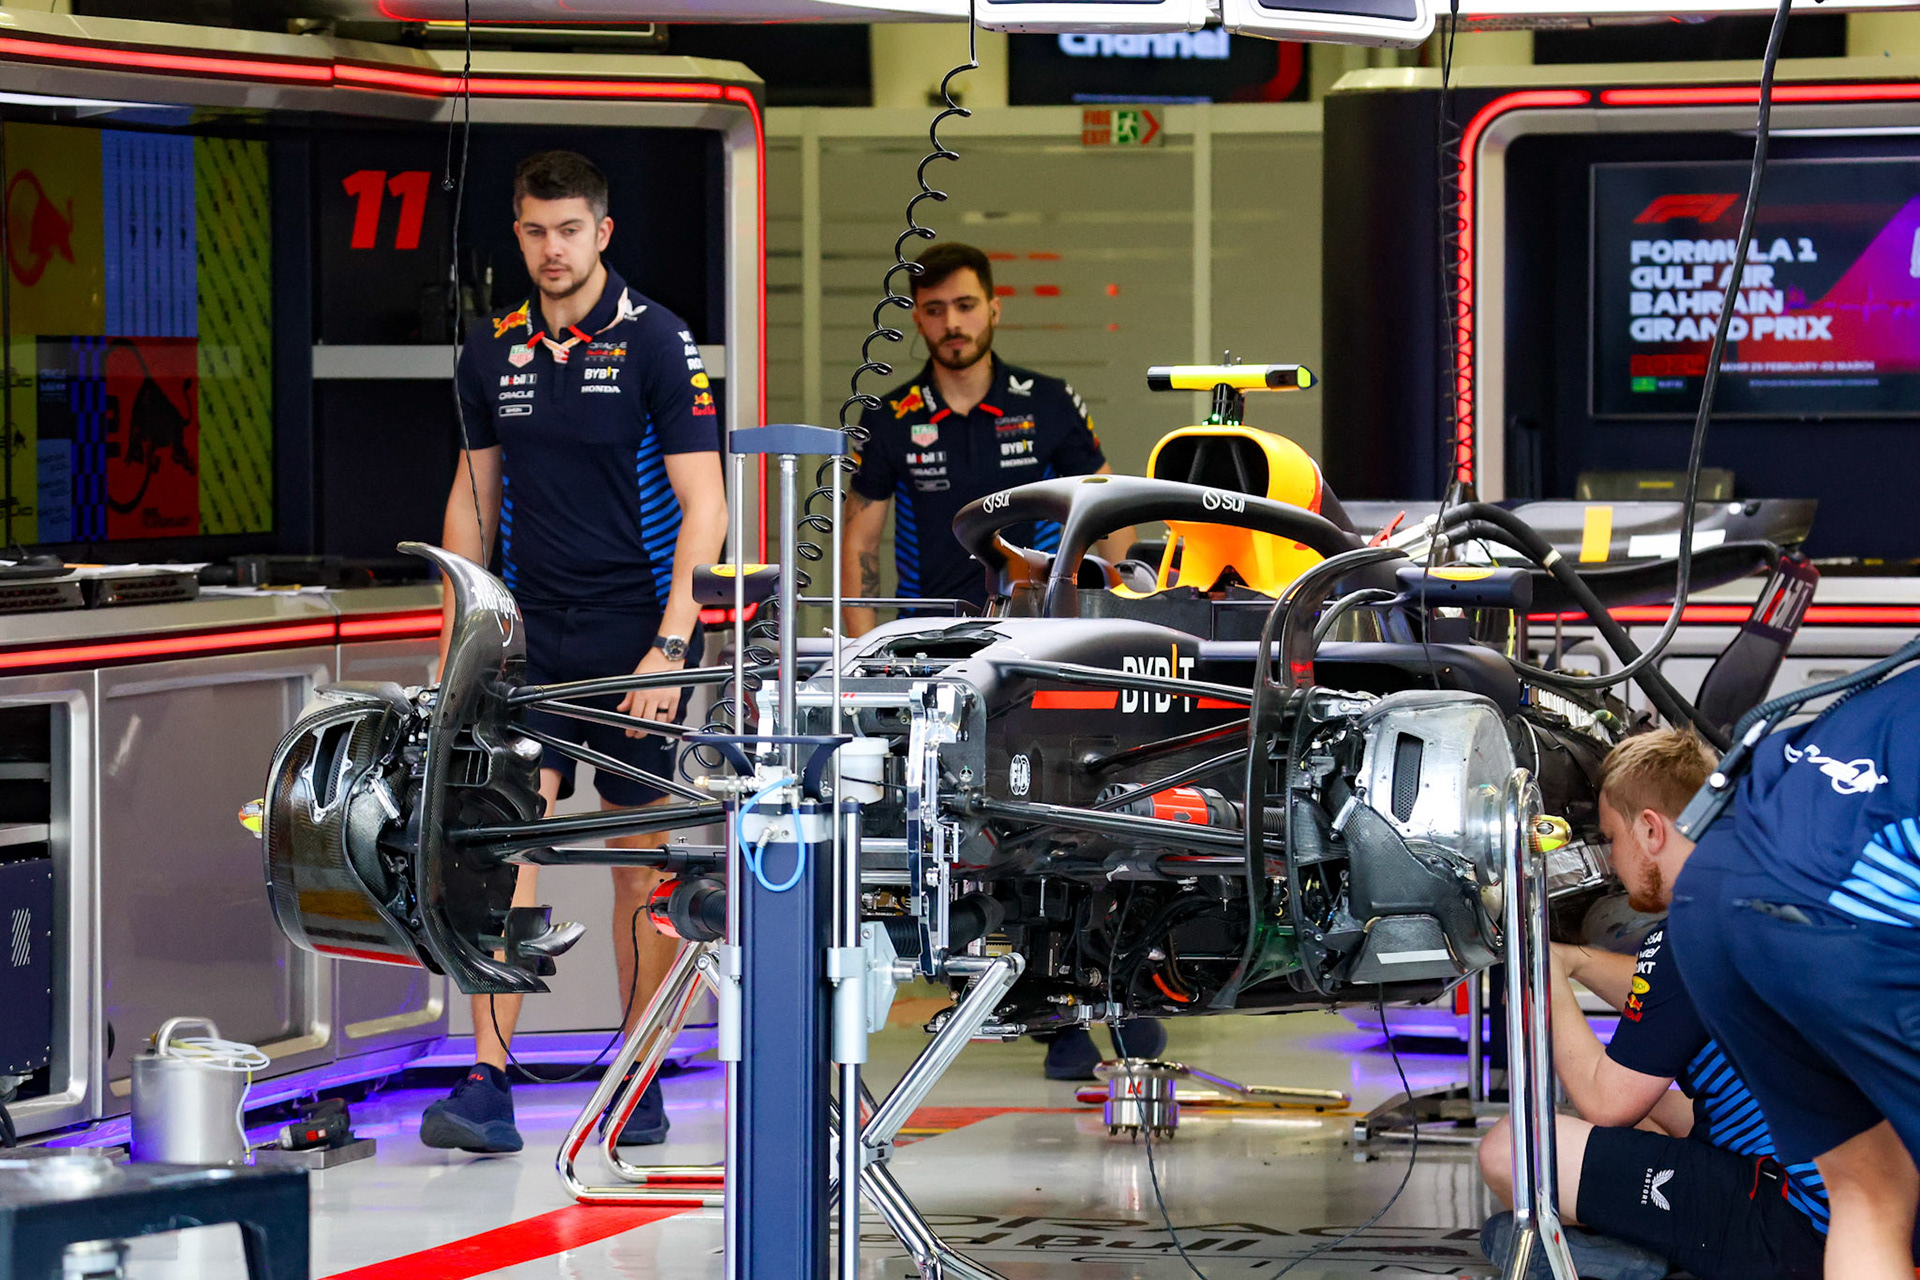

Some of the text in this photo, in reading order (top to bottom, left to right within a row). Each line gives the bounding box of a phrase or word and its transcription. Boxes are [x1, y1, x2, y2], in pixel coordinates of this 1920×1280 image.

[342, 169, 431, 250] 11
[1629, 264, 1775, 289] GULF AIR
[1629, 289, 1784, 316] BAHRAIN
[1629, 315, 1832, 342] GRAND PRIX
[500, 374, 526, 387] Mobil
[584, 366, 620, 380] BYBIT
[499, 390, 534, 400] ORACLE
[581, 385, 621, 393] HONDA
[1001, 439, 1034, 454] BYBIT
[1641, 1168, 1653, 1205] CASTORE
[1015, 1233, 1263, 1251] Bull
